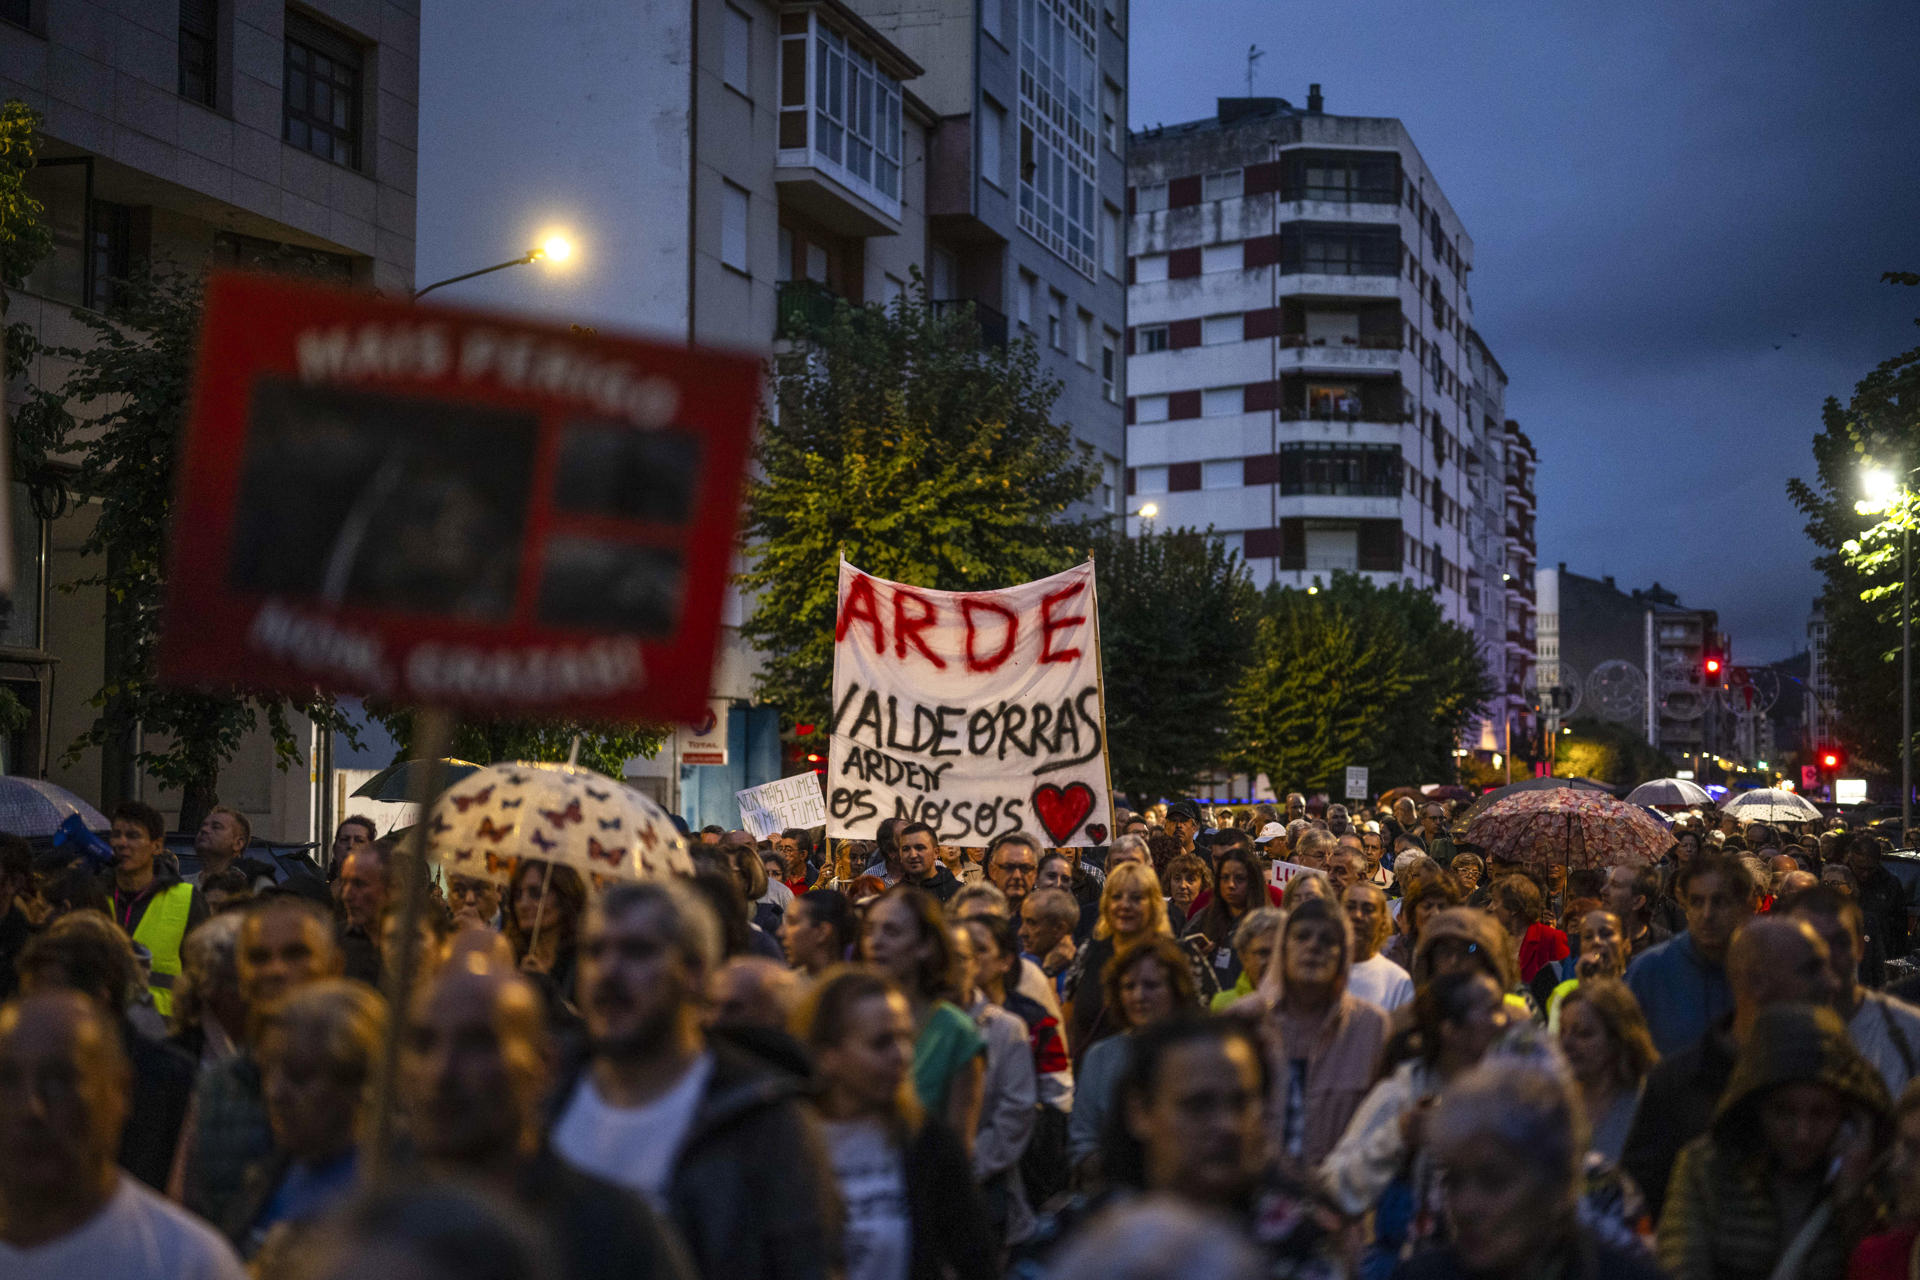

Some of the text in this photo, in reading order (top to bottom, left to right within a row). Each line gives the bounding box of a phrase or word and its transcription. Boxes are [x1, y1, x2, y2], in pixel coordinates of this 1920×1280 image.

[835, 573, 1086, 672] ARDE
[688, 741, 718, 749] TOTAL
[841, 746, 954, 792] ARDEN
[783, 775, 820, 801] LUMES
[790, 796, 826, 826] FUMES
[829, 787, 878, 829] OS
